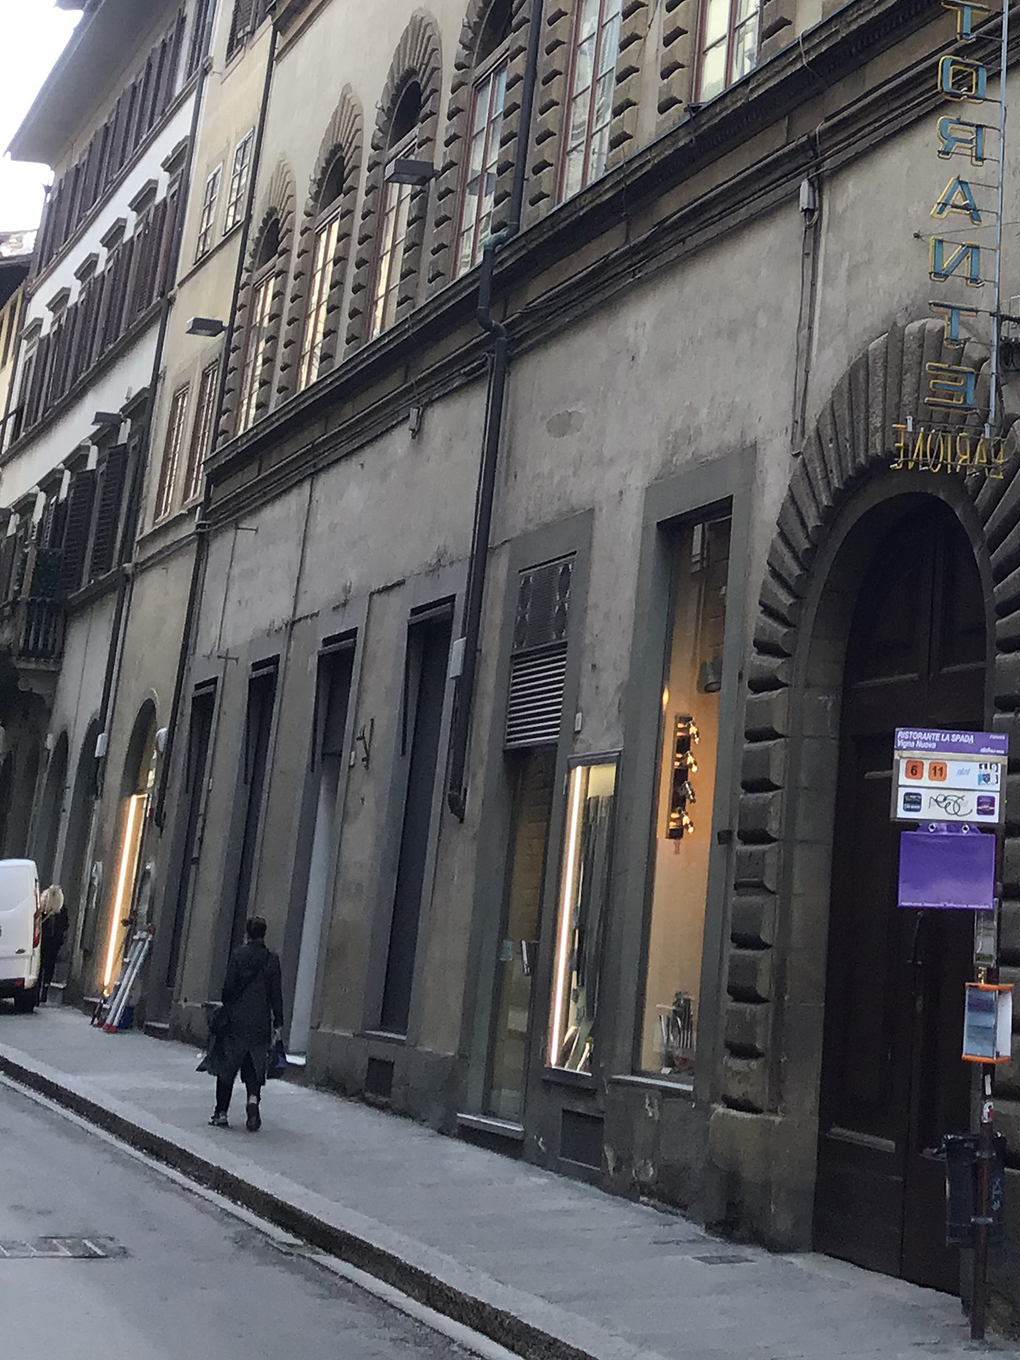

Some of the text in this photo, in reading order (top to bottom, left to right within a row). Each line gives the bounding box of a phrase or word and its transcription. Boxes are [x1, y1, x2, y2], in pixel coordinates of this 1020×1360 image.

[897, 731, 974, 744] RISTORANTE LA SPADA
[897, 739, 937, 749] Vigna Nuova
[910, 765, 918, 776] 6
[932, 765, 944, 777] 11
